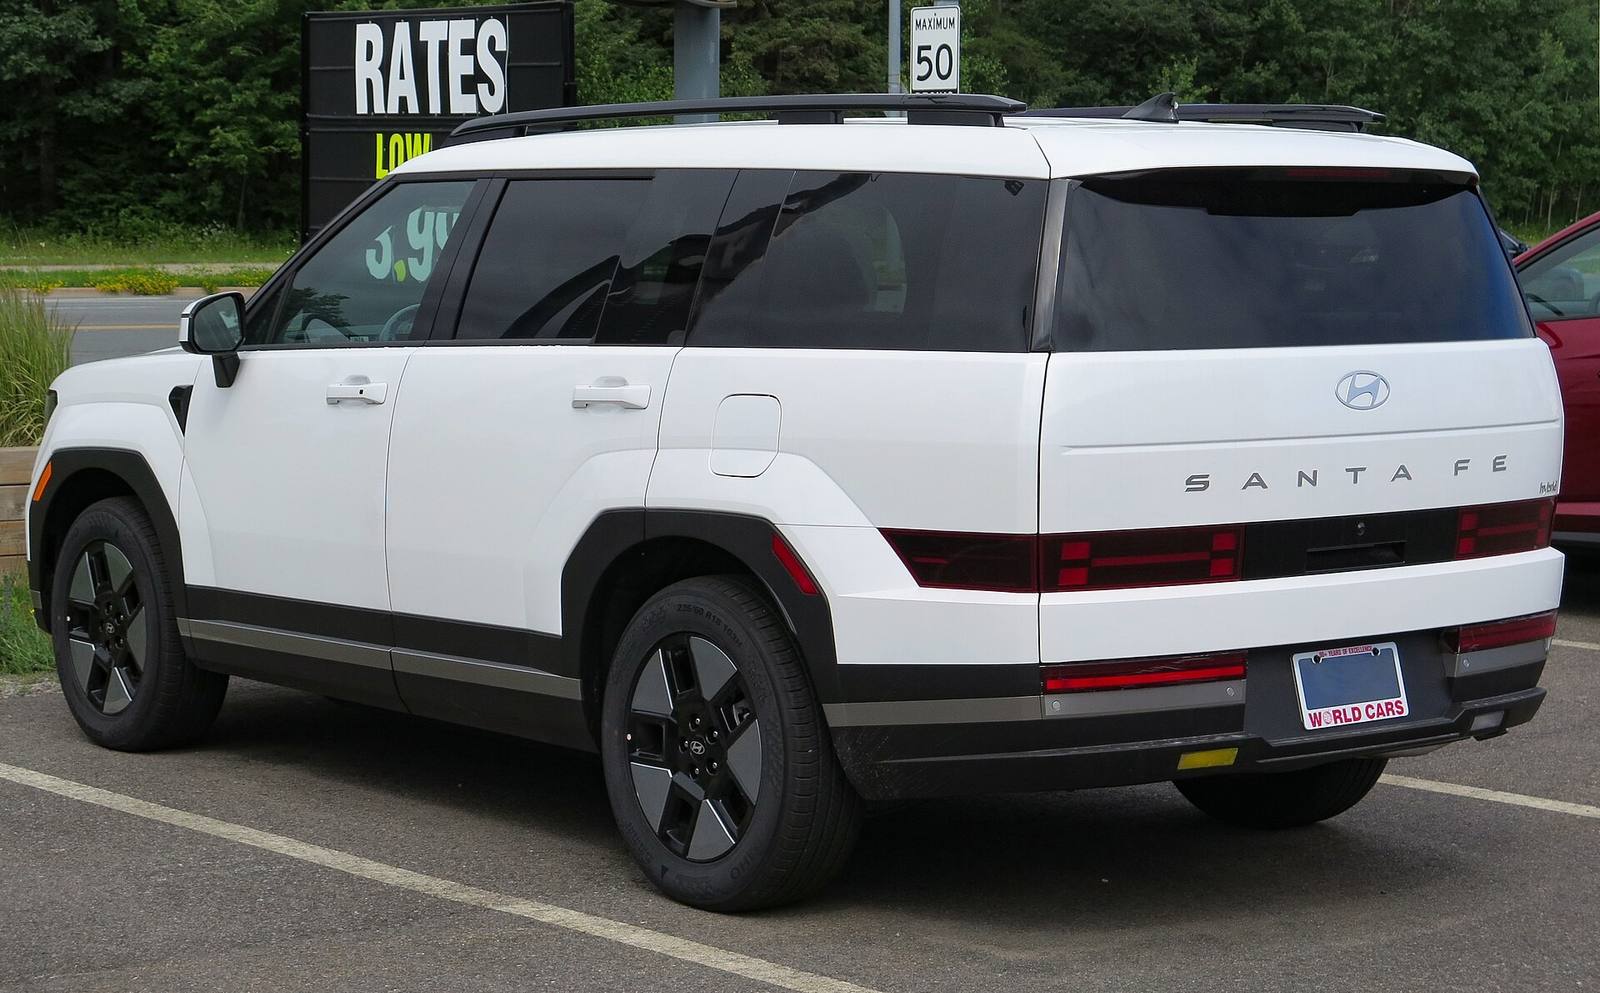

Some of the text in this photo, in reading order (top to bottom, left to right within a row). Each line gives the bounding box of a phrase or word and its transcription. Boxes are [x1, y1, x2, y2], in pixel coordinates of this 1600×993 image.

[915, 17, 955, 31] MAXIMUM
[355, 18, 507, 114] RATES
[916, 43, 953, 82] 50
[1184, 454, 1507, 492] SANTA FE
[1365, 699, 1405, 720] CARS
